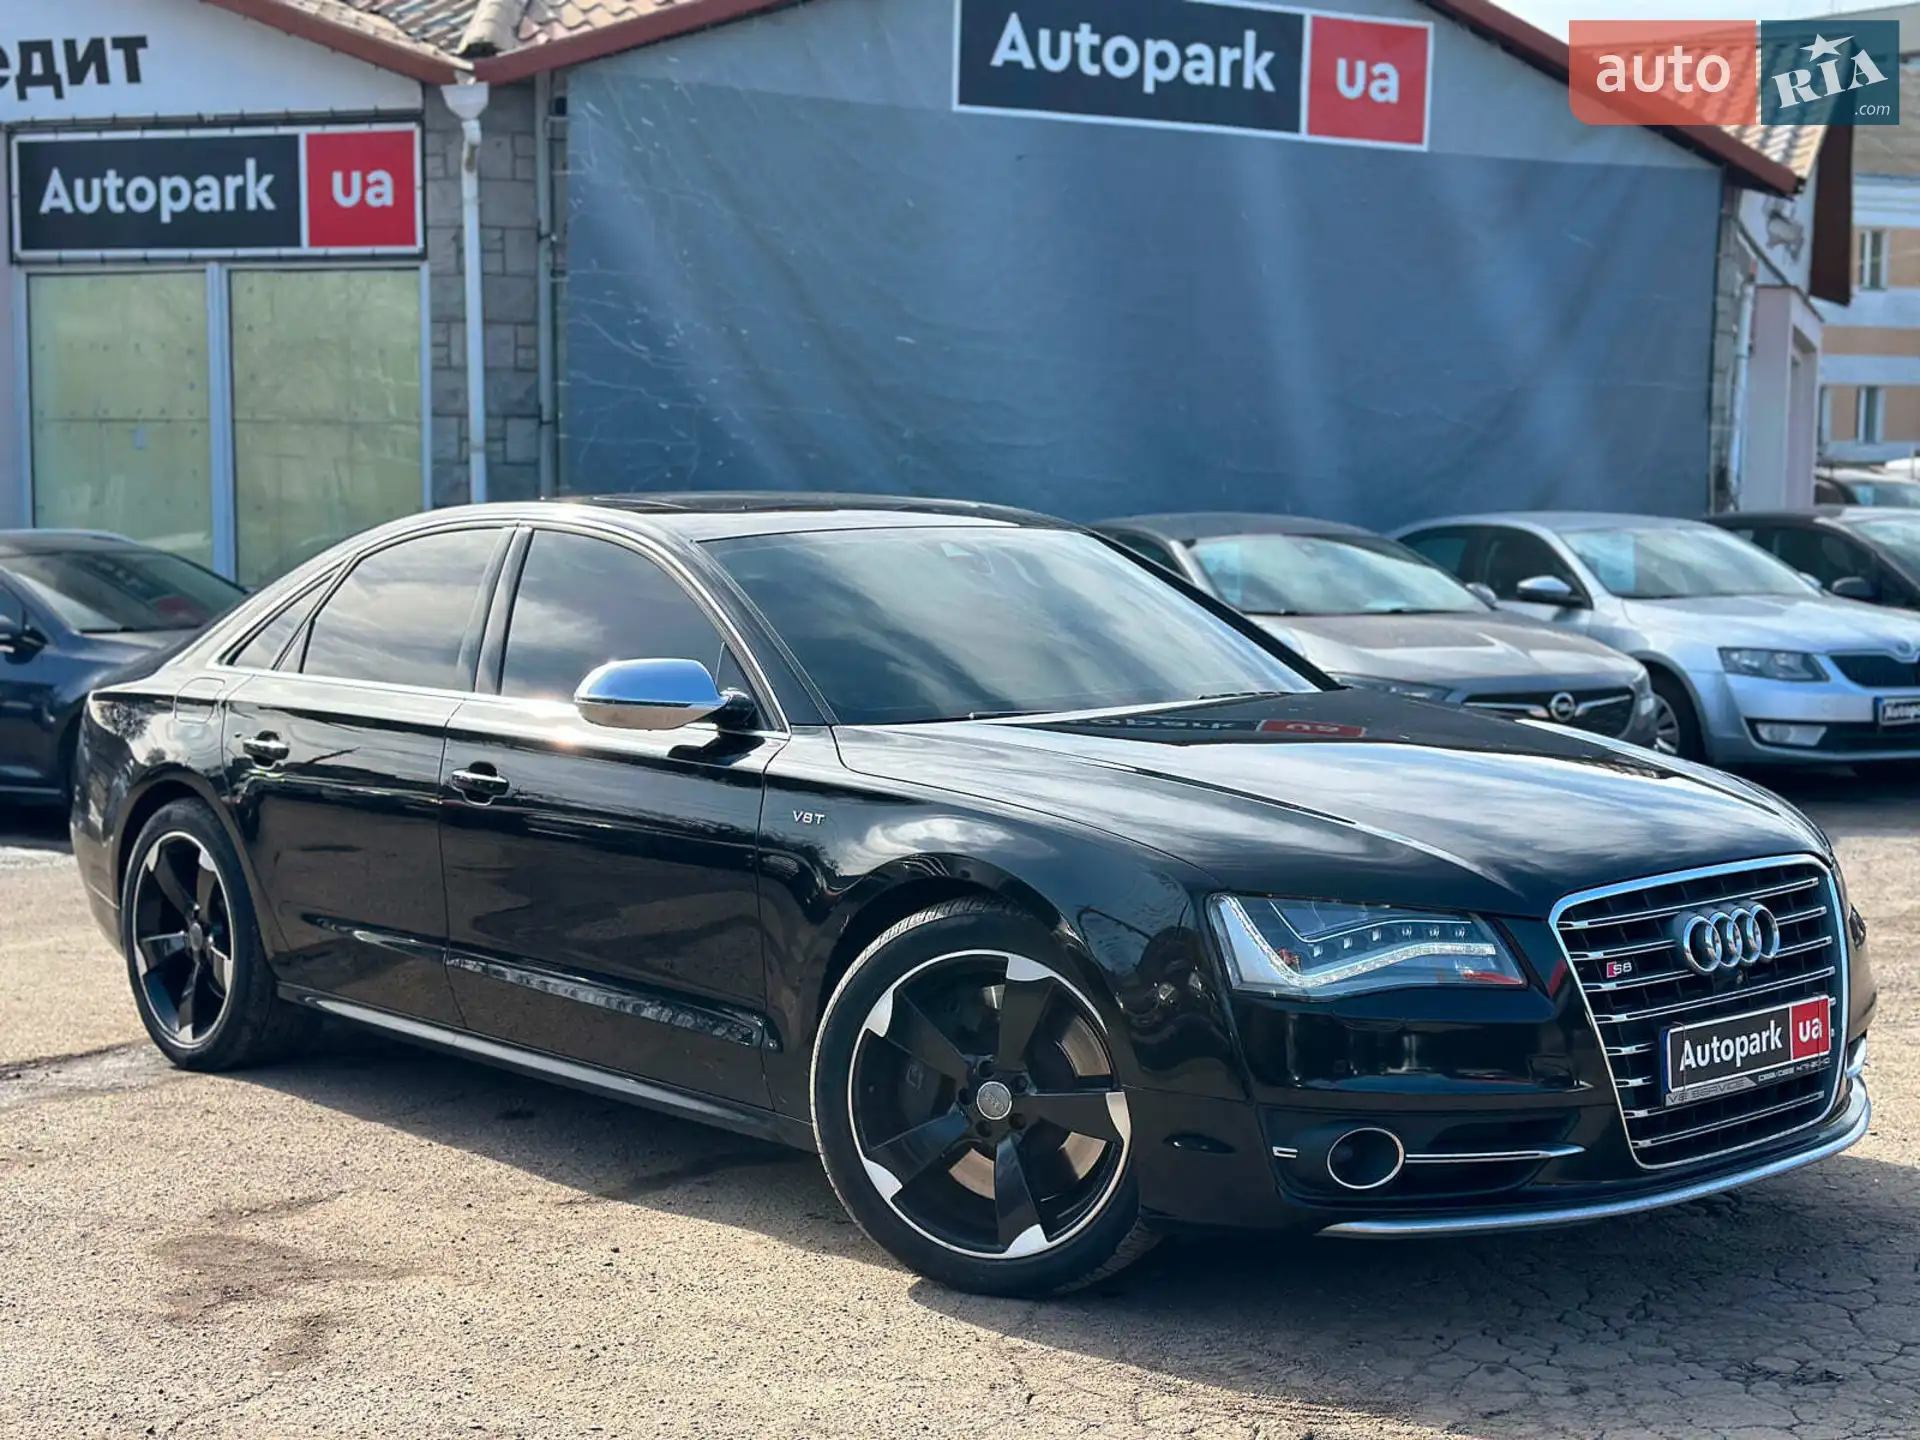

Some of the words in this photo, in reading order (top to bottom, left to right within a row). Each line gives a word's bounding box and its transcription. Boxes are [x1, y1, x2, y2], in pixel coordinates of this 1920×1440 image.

[0, 35, 148, 102] дит
[990, 12, 1275, 94] Autopark
[1335, 57, 1400, 104] ua
[39, 158, 276, 223] Autopark
[332, 169, 394, 208] ua
[793, 810, 825, 825] V8T
[1613, 961, 1632, 975] S8
[1680, 1020, 1783, 1071] Autopark
[1798, 1015, 1823, 1043] ua
